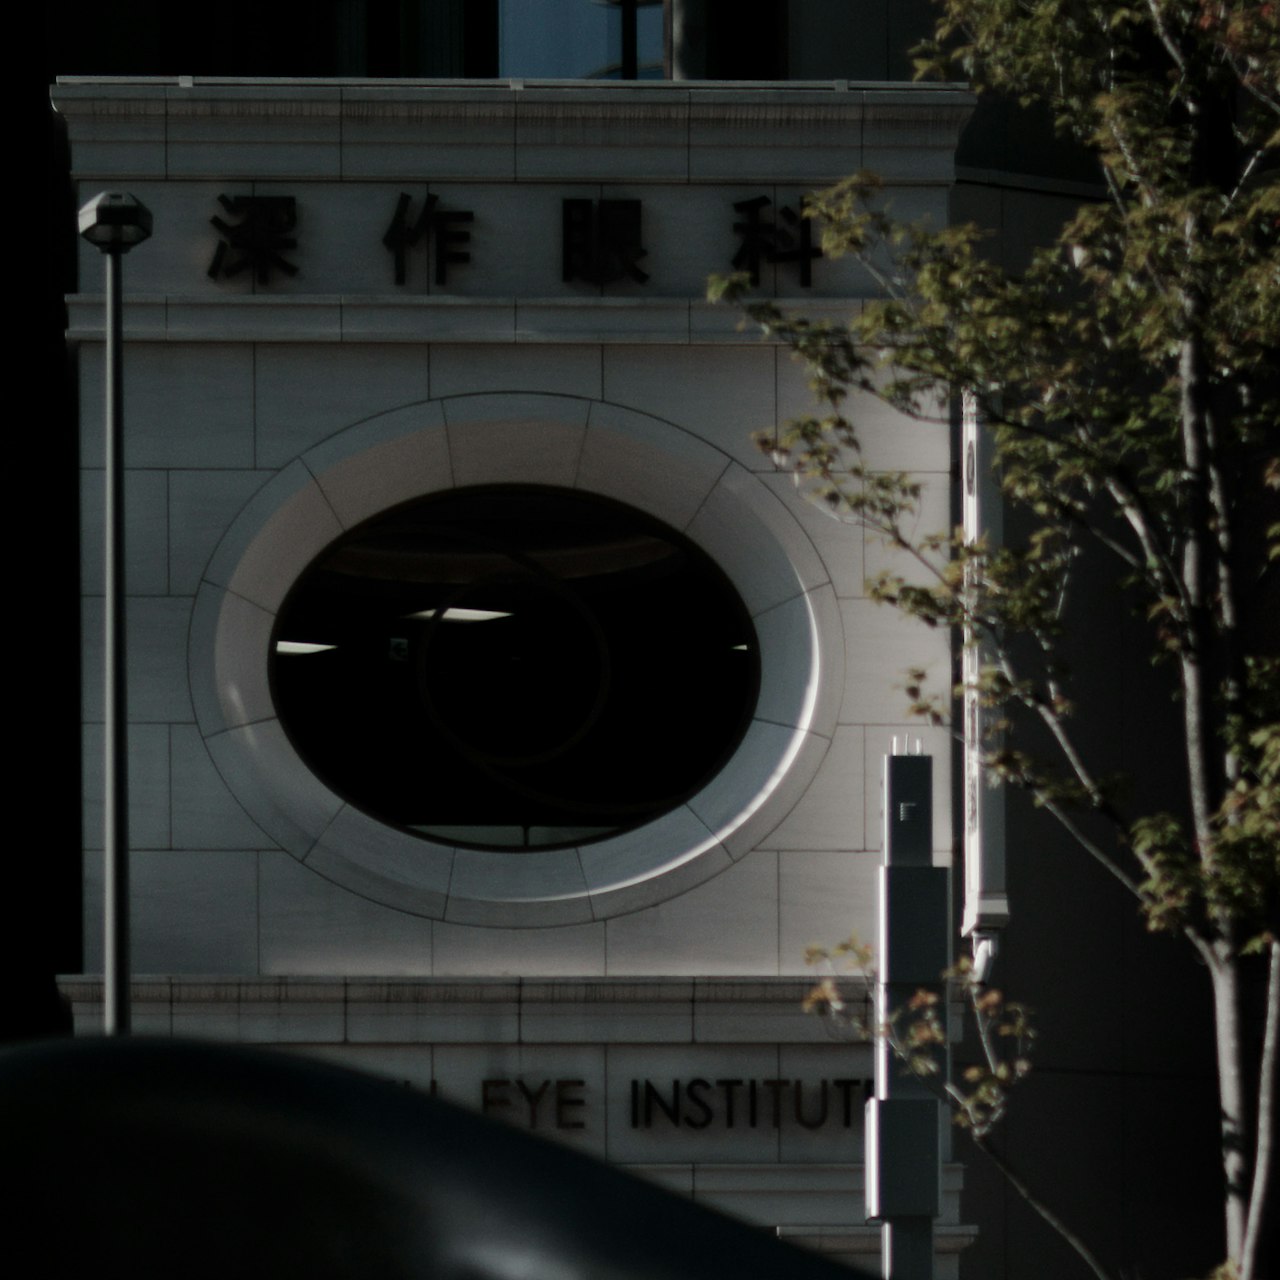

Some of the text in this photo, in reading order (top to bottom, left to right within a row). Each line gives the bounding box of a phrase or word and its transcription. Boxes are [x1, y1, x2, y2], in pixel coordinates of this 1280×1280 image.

[208, 194, 822, 286] 深作眼科
[481, 1079, 586, 1130] EYE
[631, 1079, 875, 1130] INSTITUT
